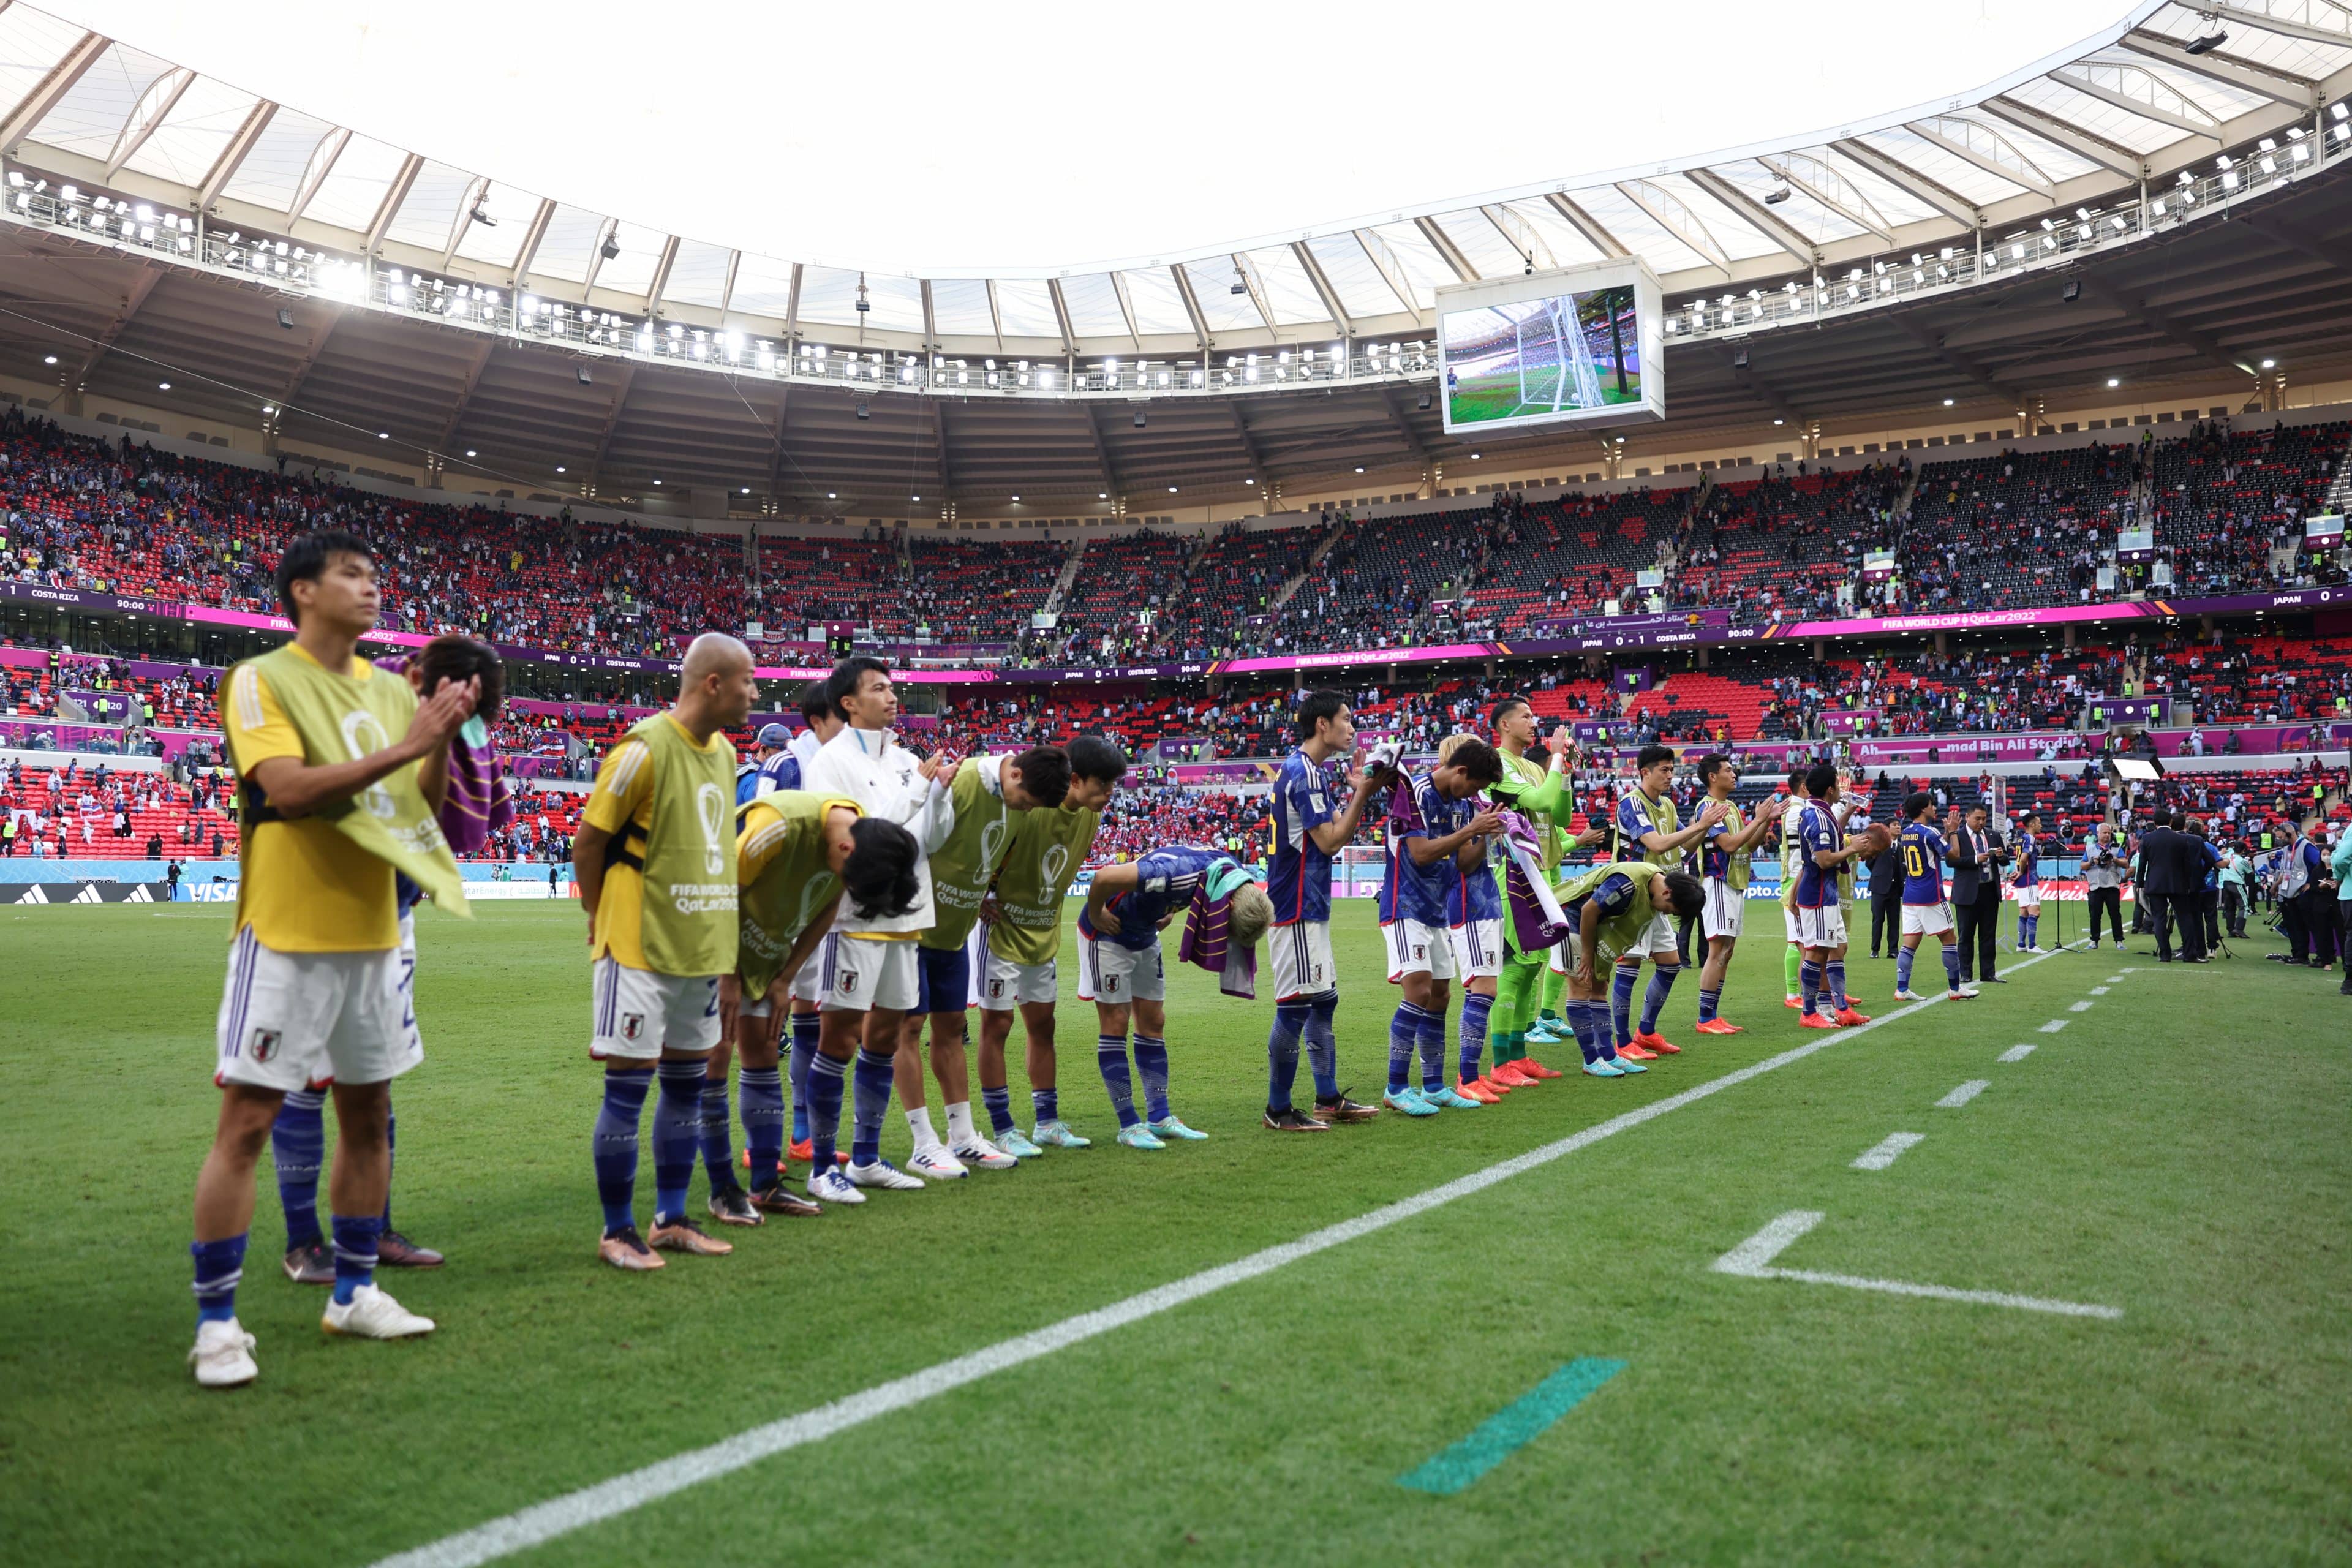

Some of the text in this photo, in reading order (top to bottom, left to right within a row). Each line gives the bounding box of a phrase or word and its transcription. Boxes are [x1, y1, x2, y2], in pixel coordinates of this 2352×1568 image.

[10, 585, 145, 610] 1 COSTA RICA 90:00
[2274, 595, 2301, 606] JAPAN
[2320, 591, 2330, 601] 0
[271, 619, 291, 628] FIFA
[1882, 620, 1904, 628] FIFA
[1904, 617, 1940, 628] WORLD
[1941, 616, 1958, 626] CUP
[1582, 639, 1602, 648] JAPAN
[1616, 637, 1623, 646] 0
[1728, 629, 1754, 638] 90:00
[1313, 655, 1338, 664] WORLD
[107, 701, 123, 710] 120
[1980, 739, 2004, 752] Bin
[2007, 737, 2026, 750] Ali
[184, 883, 238, 902] VISA
[463, 887, 507, 897] atarEnergy
[670, 884, 699, 896] FIFA
[699, 884, 730, 896] WORLD
[935, 881, 985, 899] FIFA WORL
[1004, 902, 1025, 914] FIFA
[1598, 940, 1611, 954] FIFA
